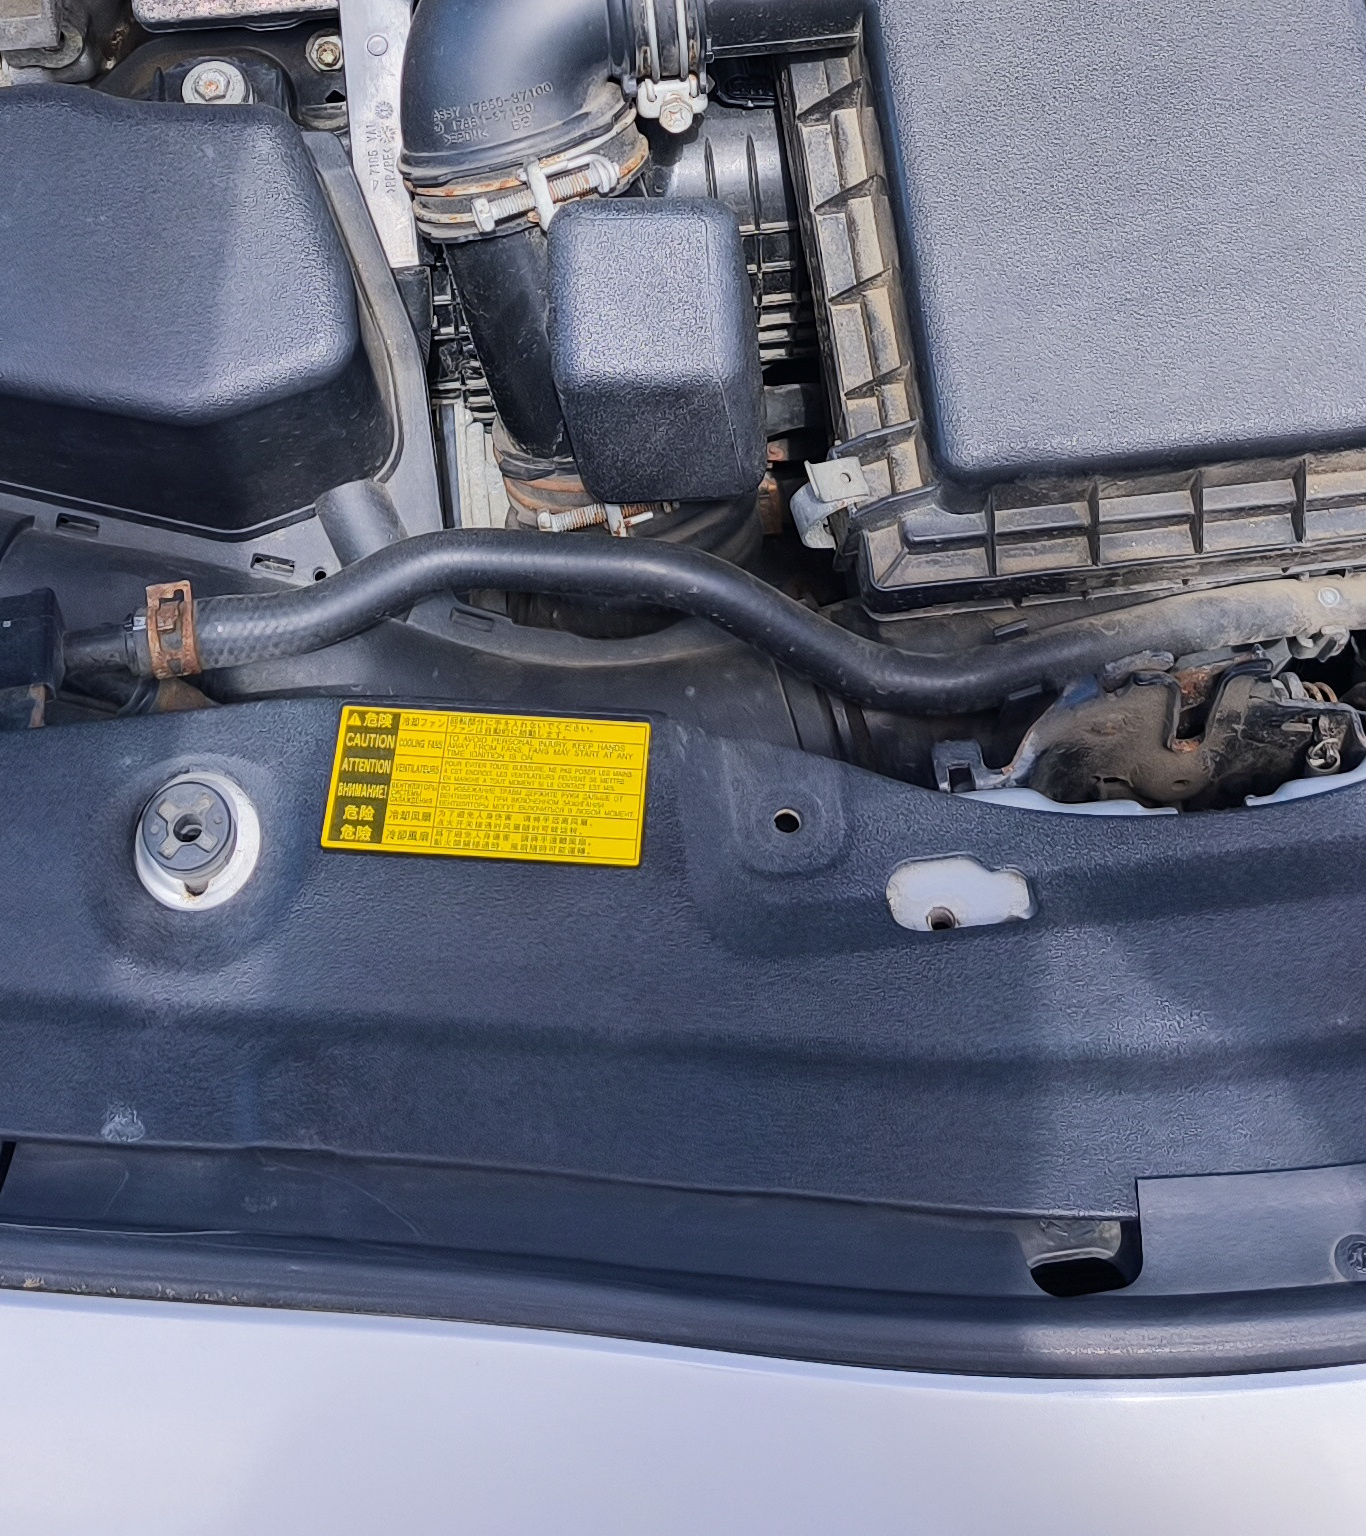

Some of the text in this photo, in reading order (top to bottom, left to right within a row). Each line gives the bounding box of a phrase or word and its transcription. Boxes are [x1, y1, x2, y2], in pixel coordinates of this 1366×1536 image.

[362, 712, 394, 728] 危険
[344, 731, 395, 749] CAUTION
[447, 734, 459, 742] TO
[340, 756, 391, 774] ATTENTION
[616, 752, 633, 760] ANY
[341, 803, 376, 821] 危险
[338, 823, 373, 841] 危險
